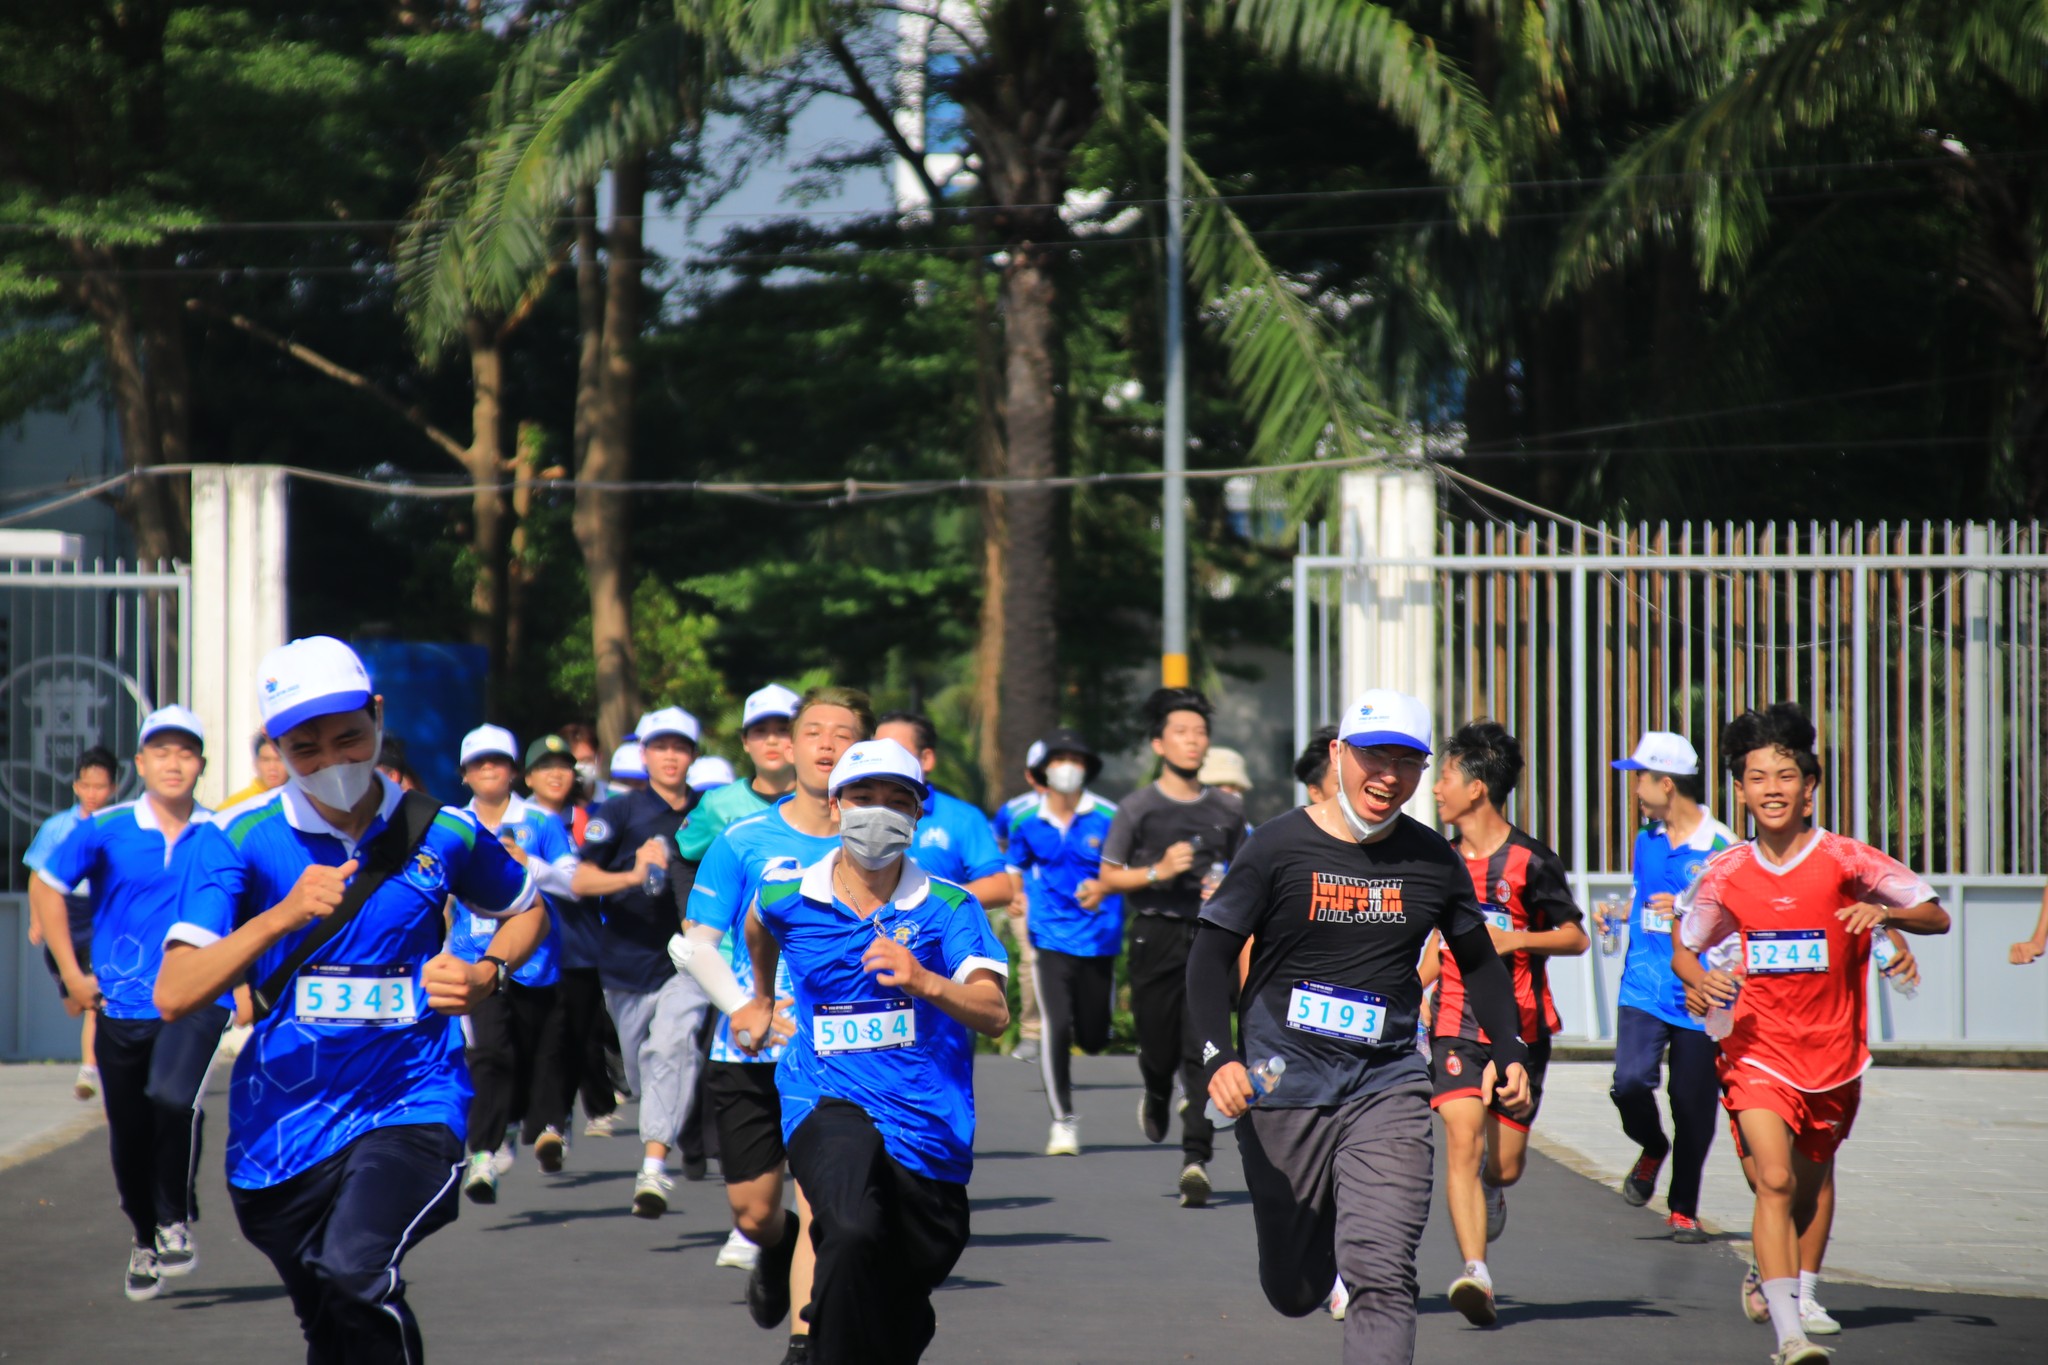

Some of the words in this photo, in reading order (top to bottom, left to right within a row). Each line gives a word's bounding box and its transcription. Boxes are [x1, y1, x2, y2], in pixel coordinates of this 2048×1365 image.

[1751, 944, 1821, 965] 5244
[306, 983, 405, 1013] 5343
[1297, 995, 1377, 1033] 5193
[821, 1014, 908, 1045] 5084
